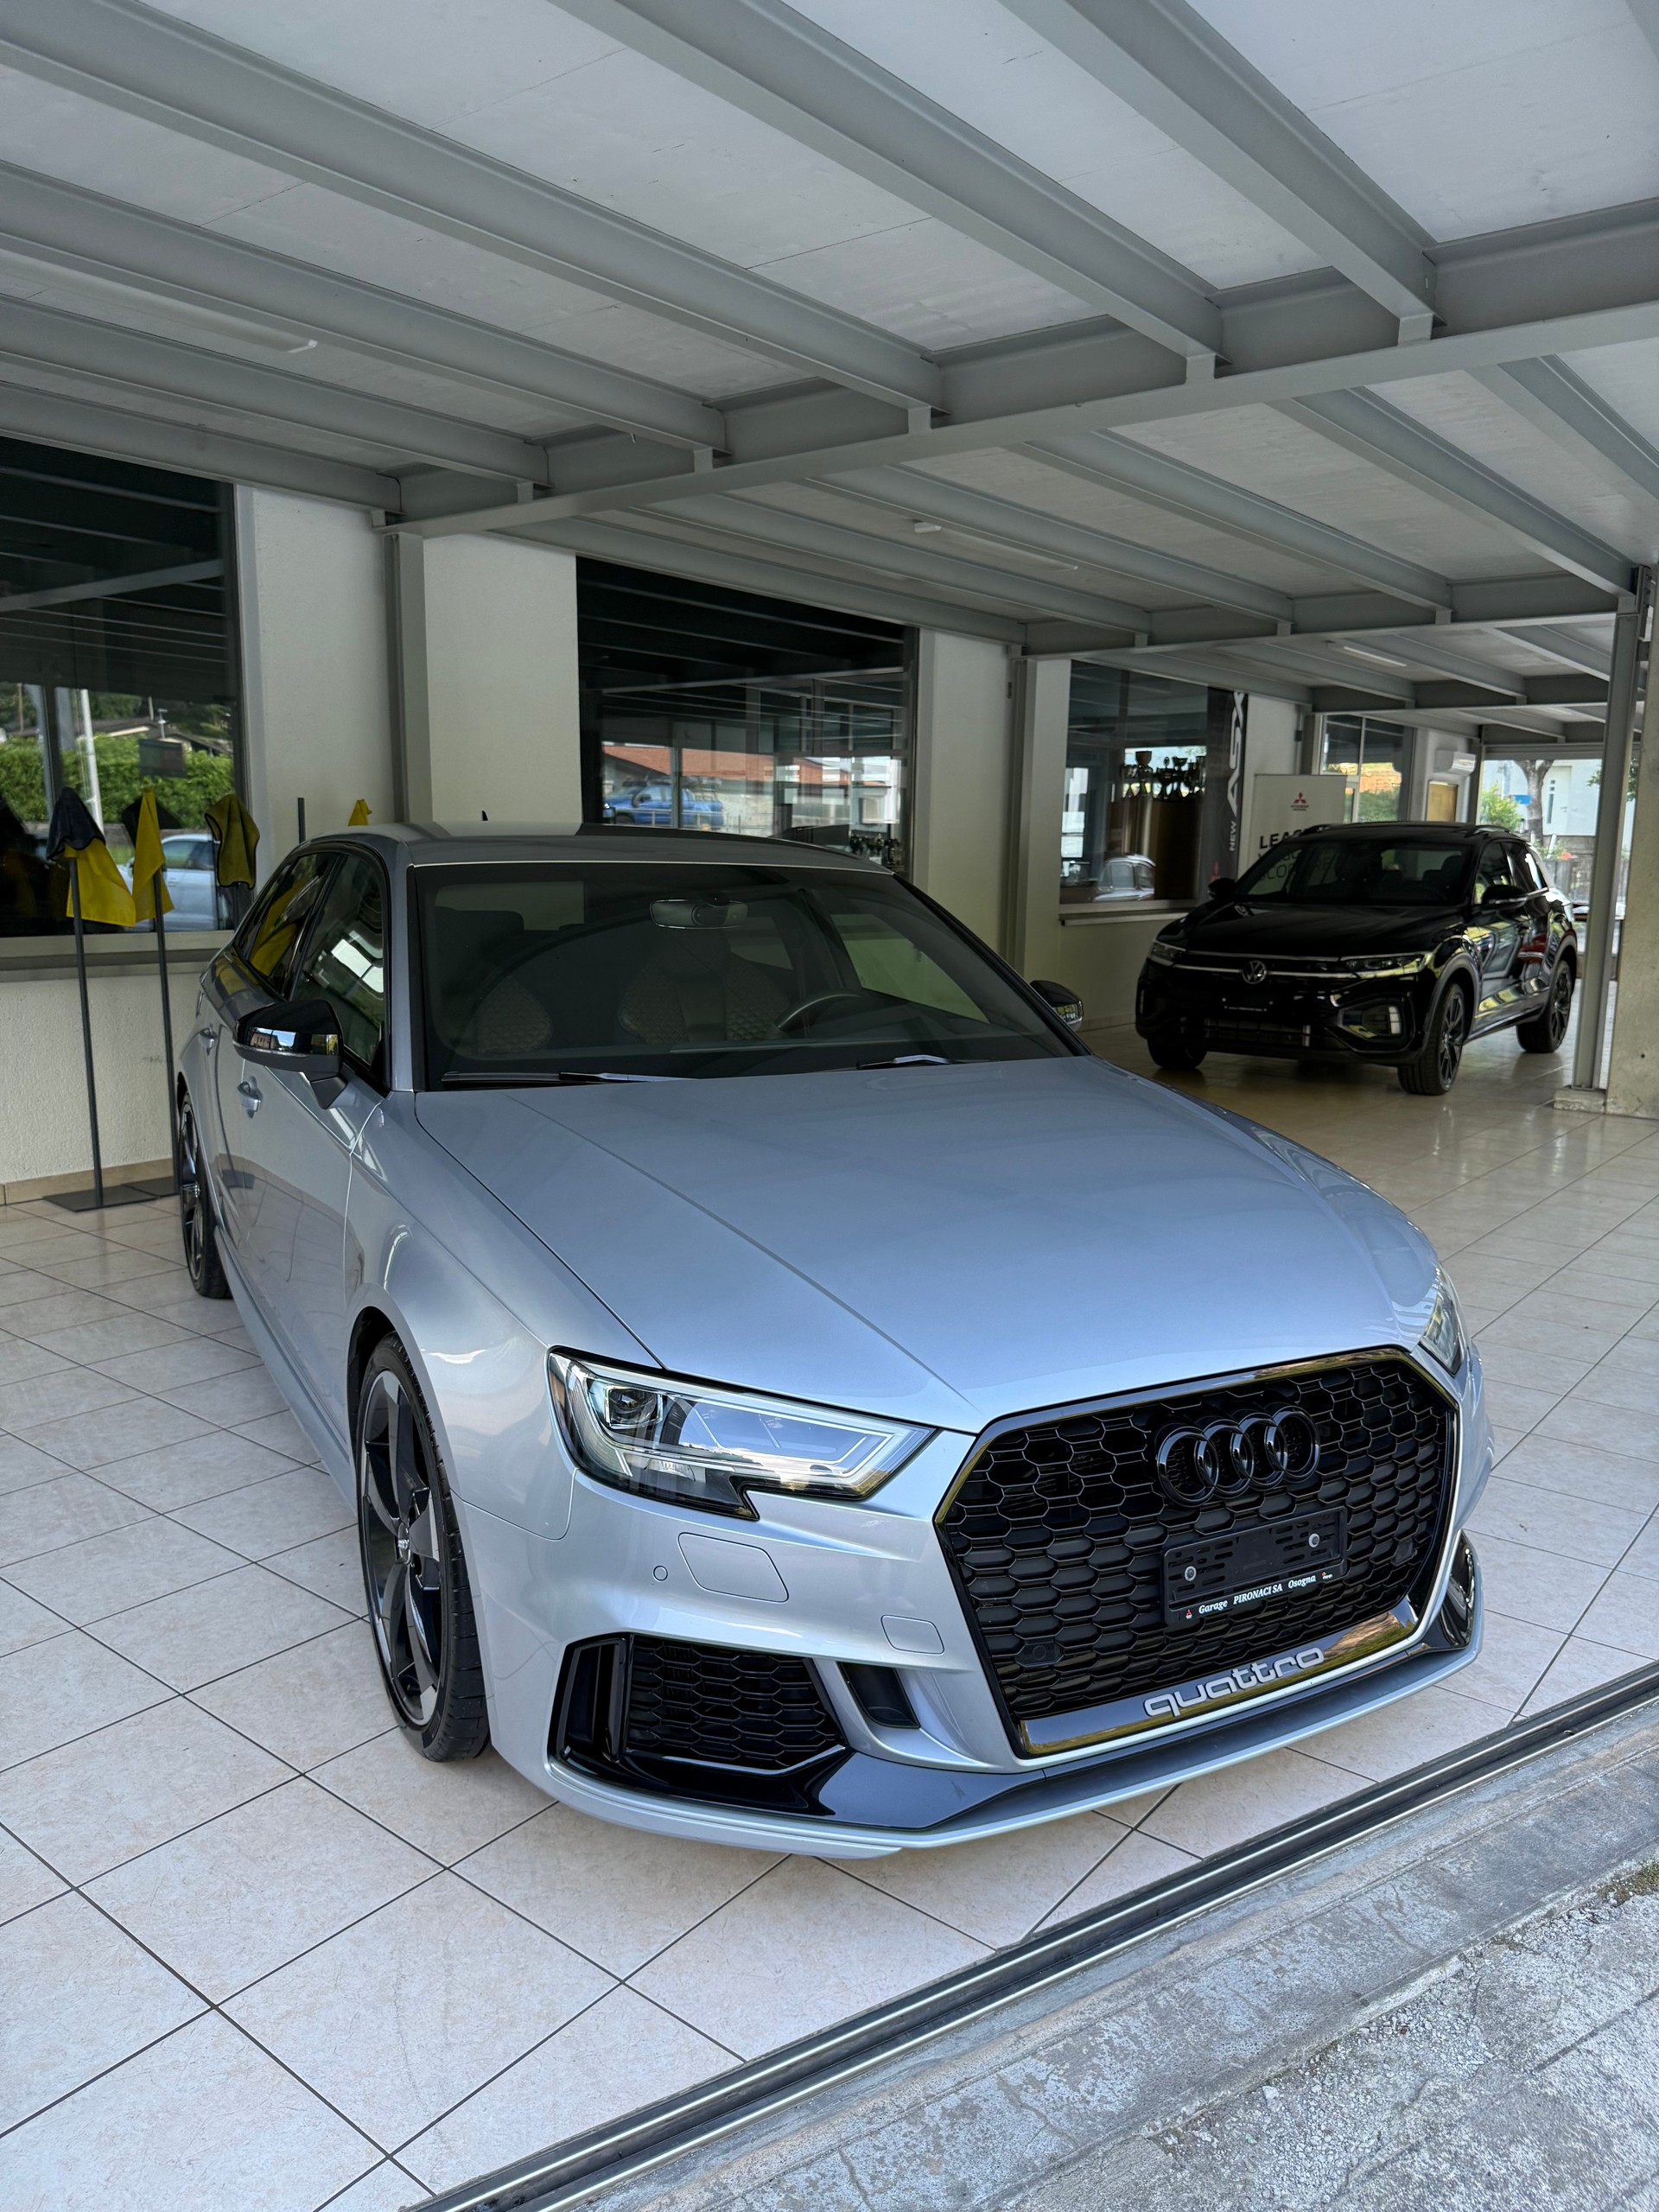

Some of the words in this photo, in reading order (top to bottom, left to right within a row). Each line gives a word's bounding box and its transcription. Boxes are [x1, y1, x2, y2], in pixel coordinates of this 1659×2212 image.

[1227, 691, 1244, 817] ASX
[1198, 1599, 1228, 1614] Garage
[1233, 1588, 1272, 1605] PIRONACI
[1272, 1583, 1283, 1594] SA
[1287, 1574, 1316, 1589] Osogna
[1144, 1647, 1325, 1717] quattro
